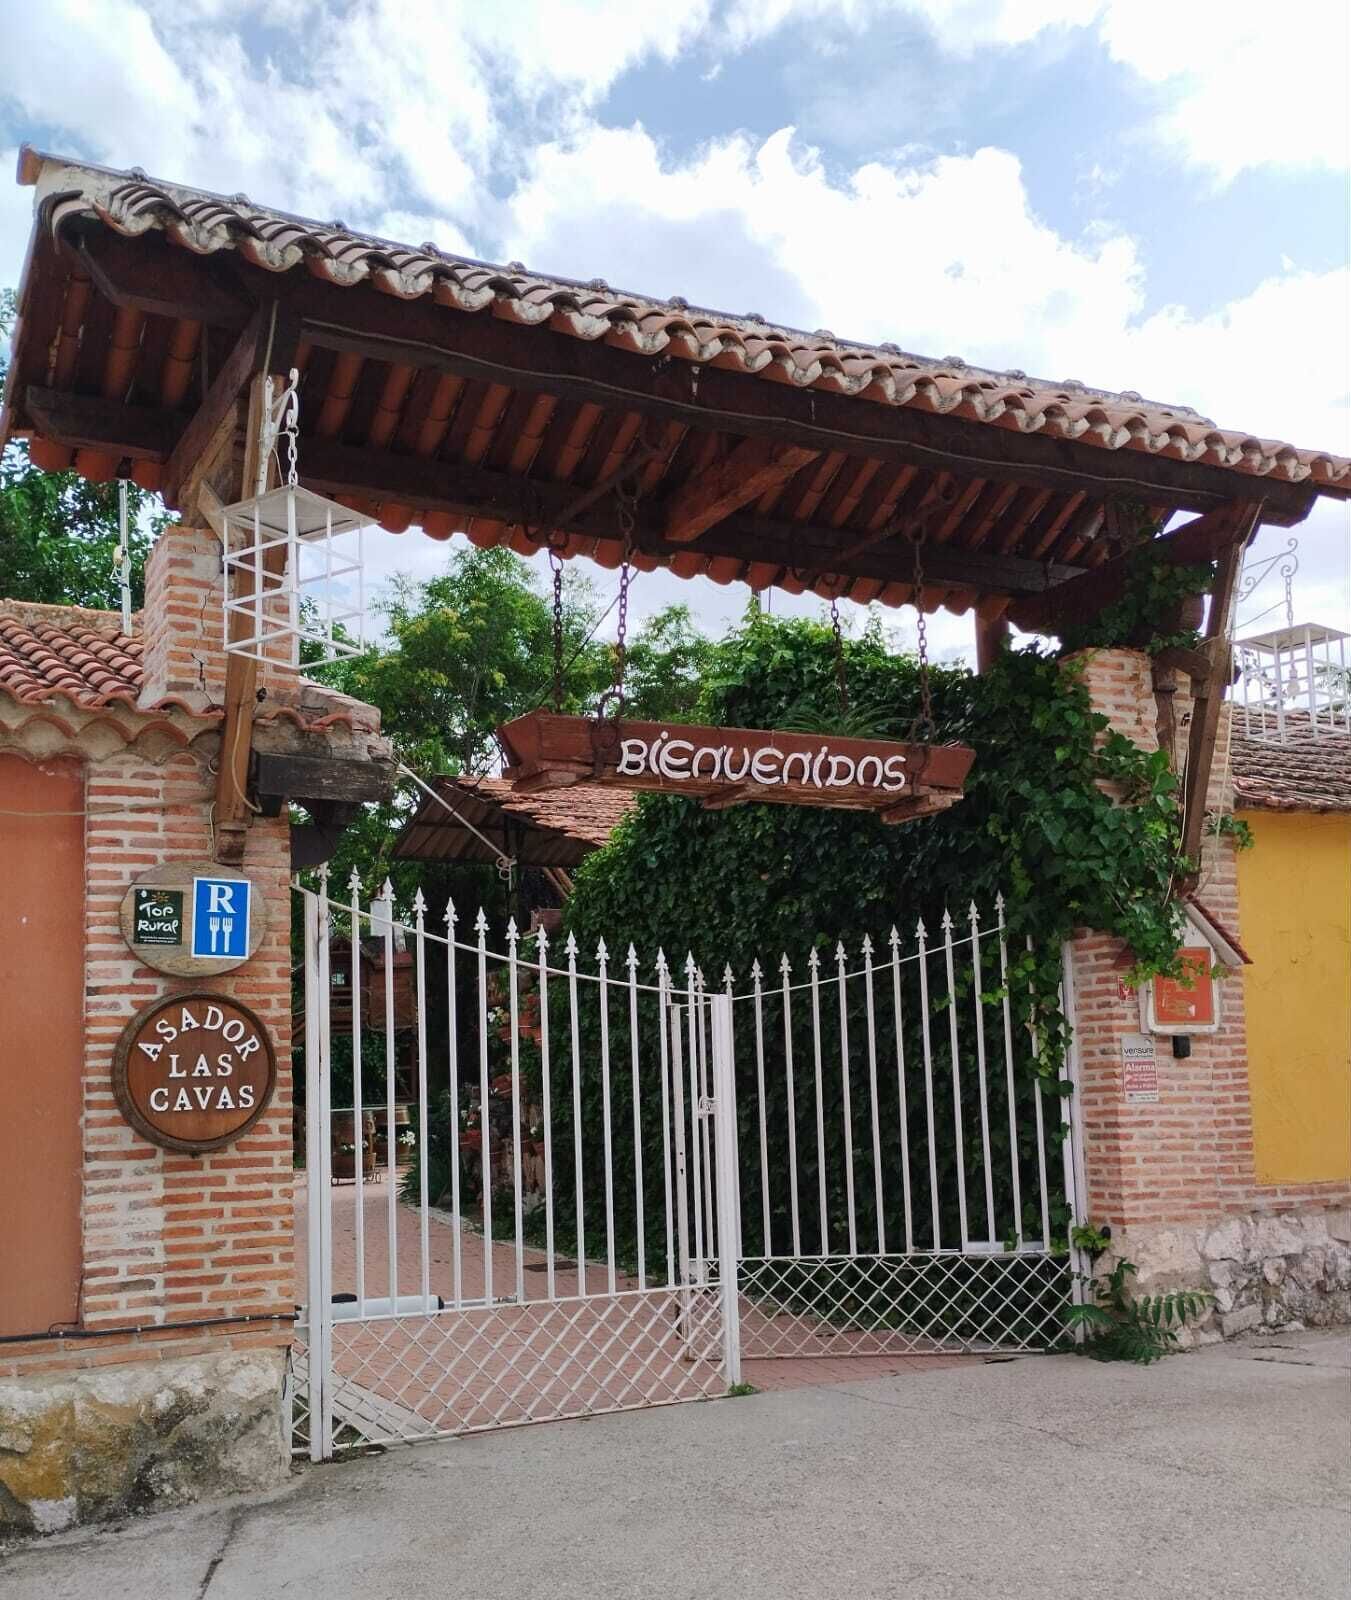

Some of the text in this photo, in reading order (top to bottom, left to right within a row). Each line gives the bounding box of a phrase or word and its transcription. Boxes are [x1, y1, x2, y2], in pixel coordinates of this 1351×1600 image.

[206, 884, 239, 914] R
[137, 920, 179, 936] Rural
[138, 1006, 260, 1062] ASADOR
[169, 1053, 233, 1077] LAS
[1126, 1063, 1156, 1072] Alarma
[150, 1085, 255, 1112] CAVAS
